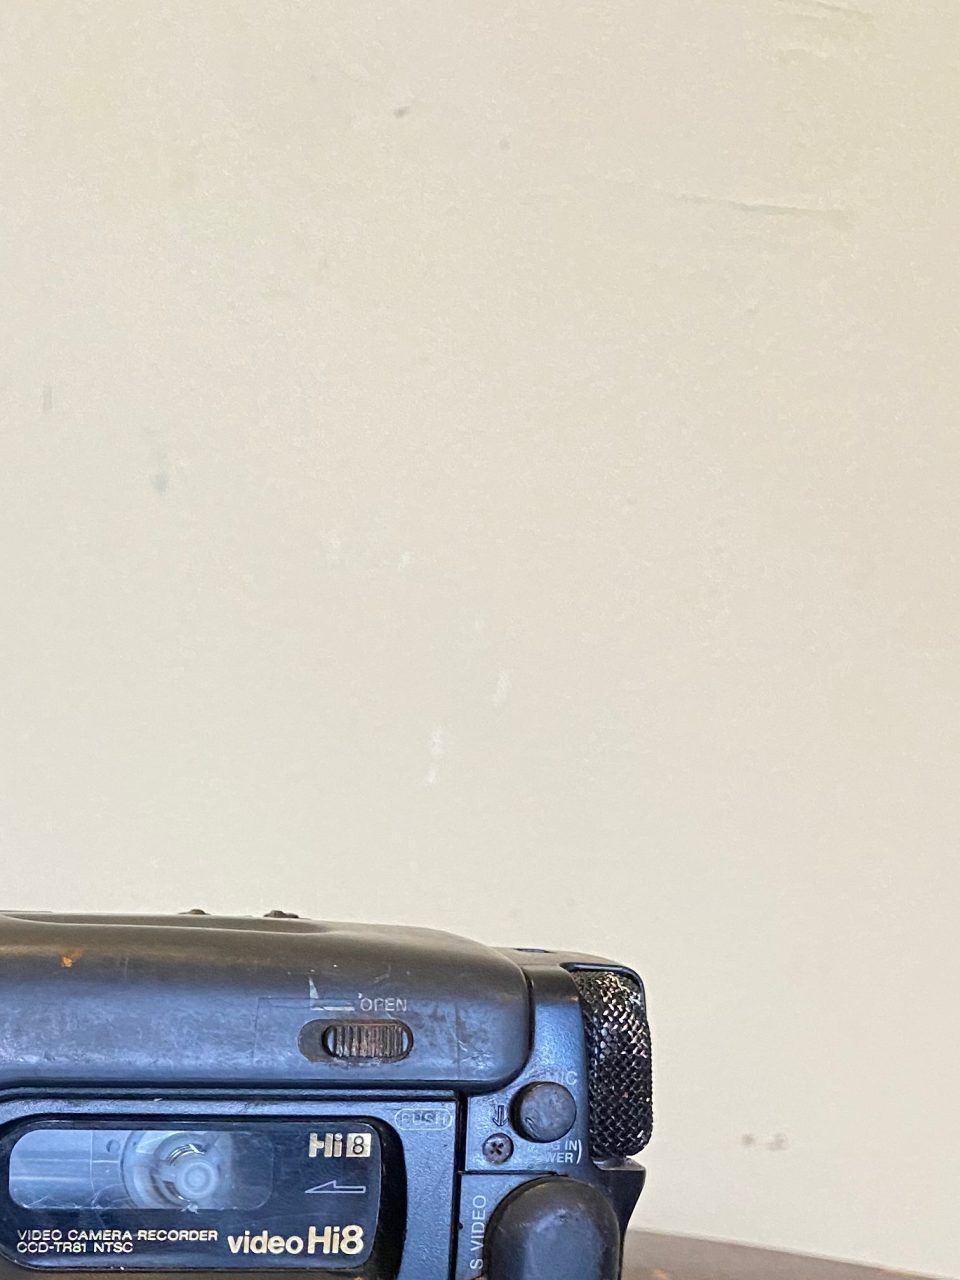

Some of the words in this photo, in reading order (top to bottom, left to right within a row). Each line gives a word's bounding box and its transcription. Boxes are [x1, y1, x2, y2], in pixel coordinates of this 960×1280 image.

[360, 998, 407, 1012] OPEN
[470, 1195, 487, 1252] VIDEO
[17, 1229, 62, 1241] VIDEO
[67, 1229, 132, 1241] CAMERA
[137, 1229, 218, 1241] RECORDER
[16, 1241, 86, 1253] CCD-TR81
[93, 1241, 134, 1253] NTSC
[469, 1258, 483, 1270] S
